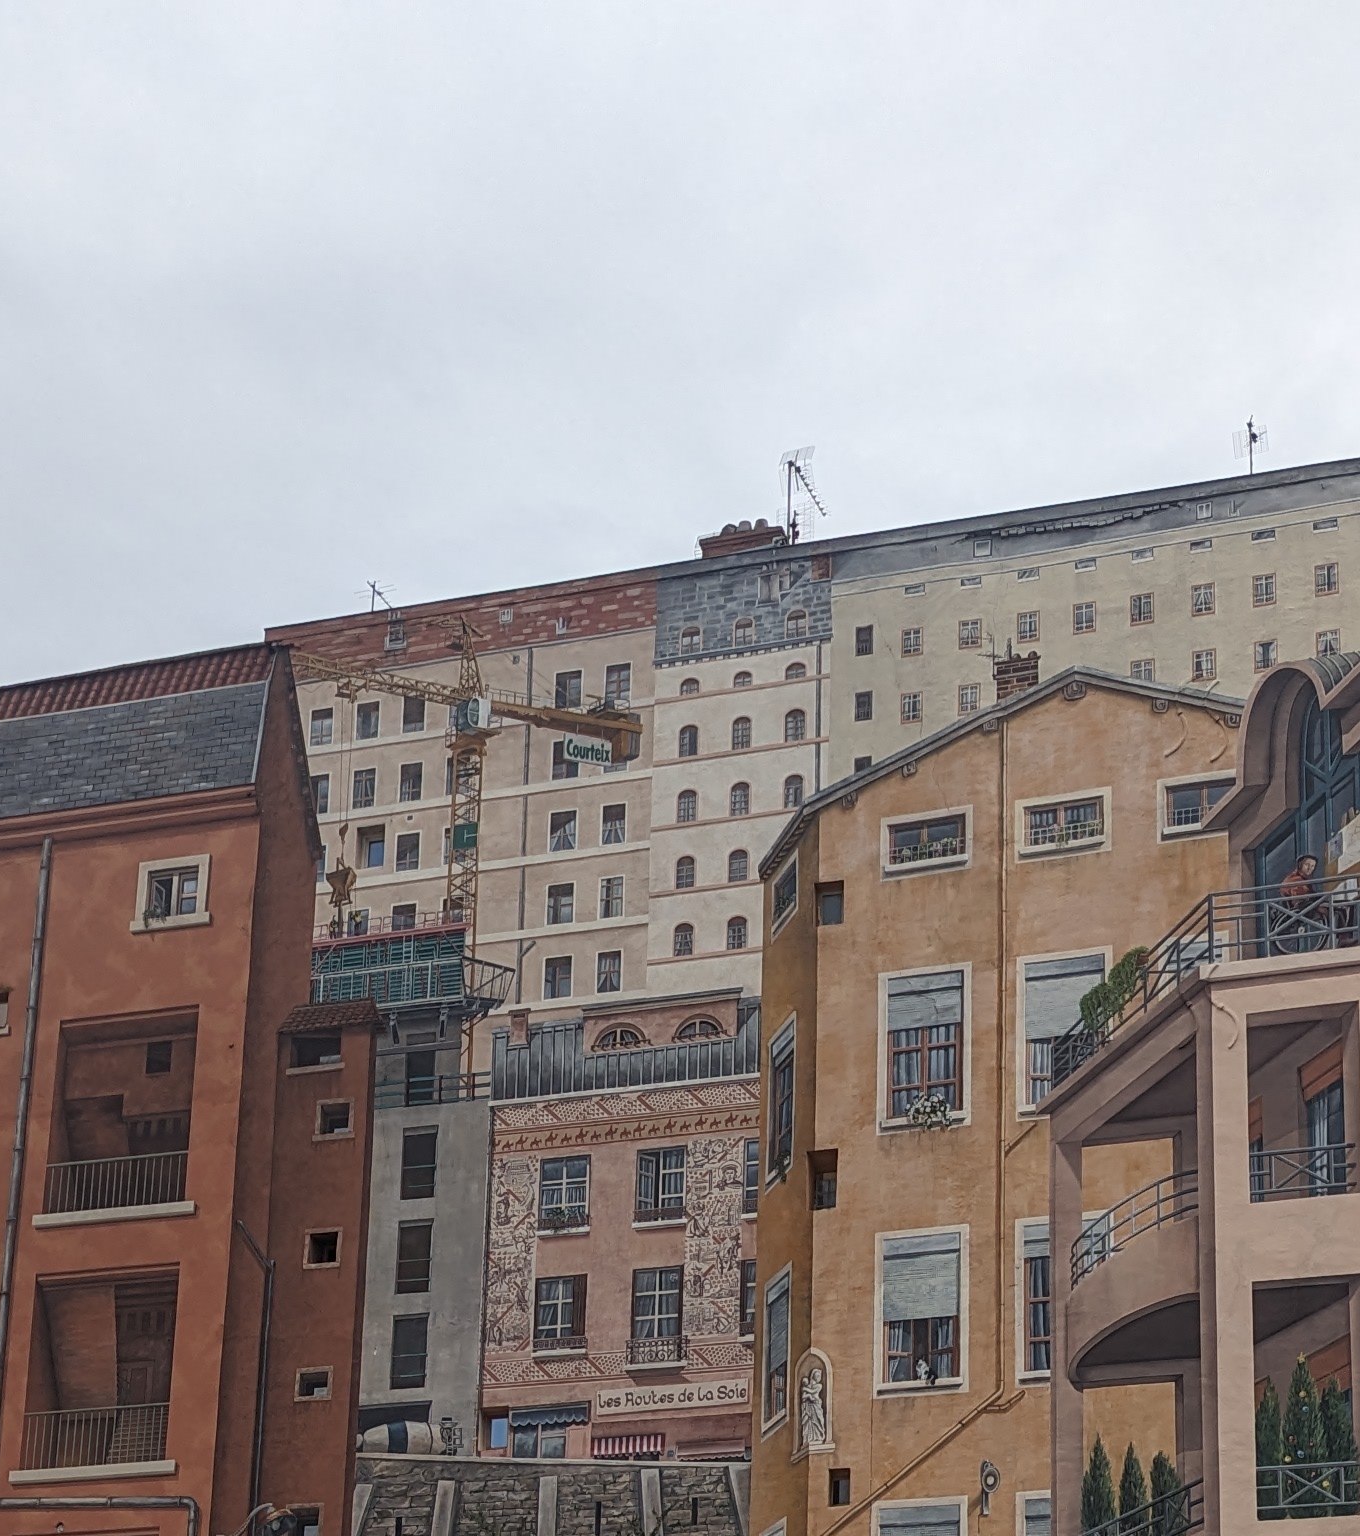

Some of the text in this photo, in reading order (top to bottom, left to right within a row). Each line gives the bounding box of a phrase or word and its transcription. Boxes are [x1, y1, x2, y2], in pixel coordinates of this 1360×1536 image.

[566, 738, 610, 763] Courteix
[597, 1393, 622, 1408] Les
[624, 1391, 674, 1408] Routes
[677, 1388, 694, 1403] de
[716, 1382, 747, 1400] Soie
